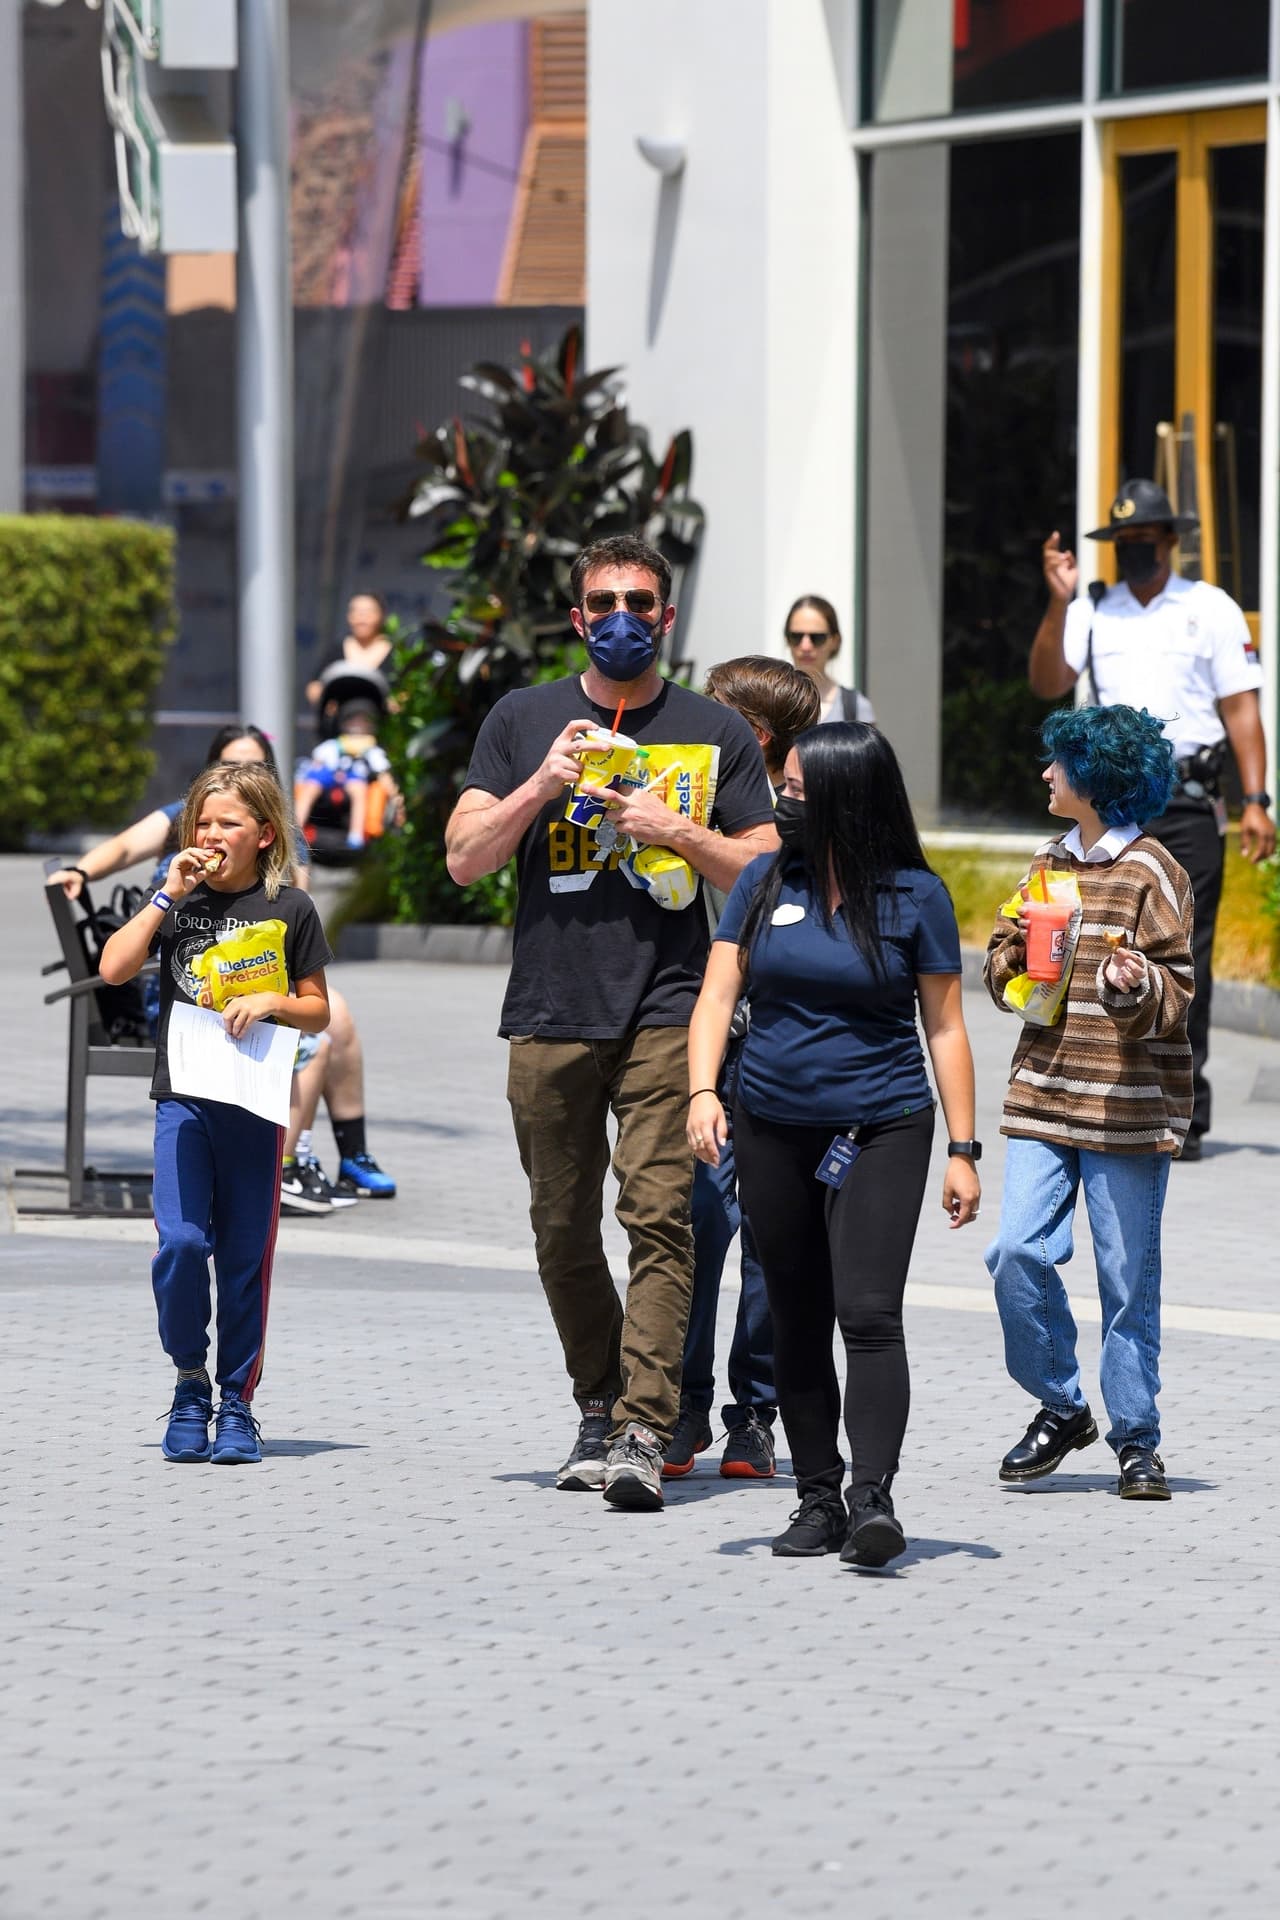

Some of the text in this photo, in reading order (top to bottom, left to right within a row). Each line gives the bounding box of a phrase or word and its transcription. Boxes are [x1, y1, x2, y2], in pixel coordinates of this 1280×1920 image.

[675, 772, 690, 816] zel's
[174, 911, 212, 932] LORD
[226, 917, 256, 931] RIN
[218, 950, 277, 973] Wetzel's
[219, 963, 279, 986] Pretzels
